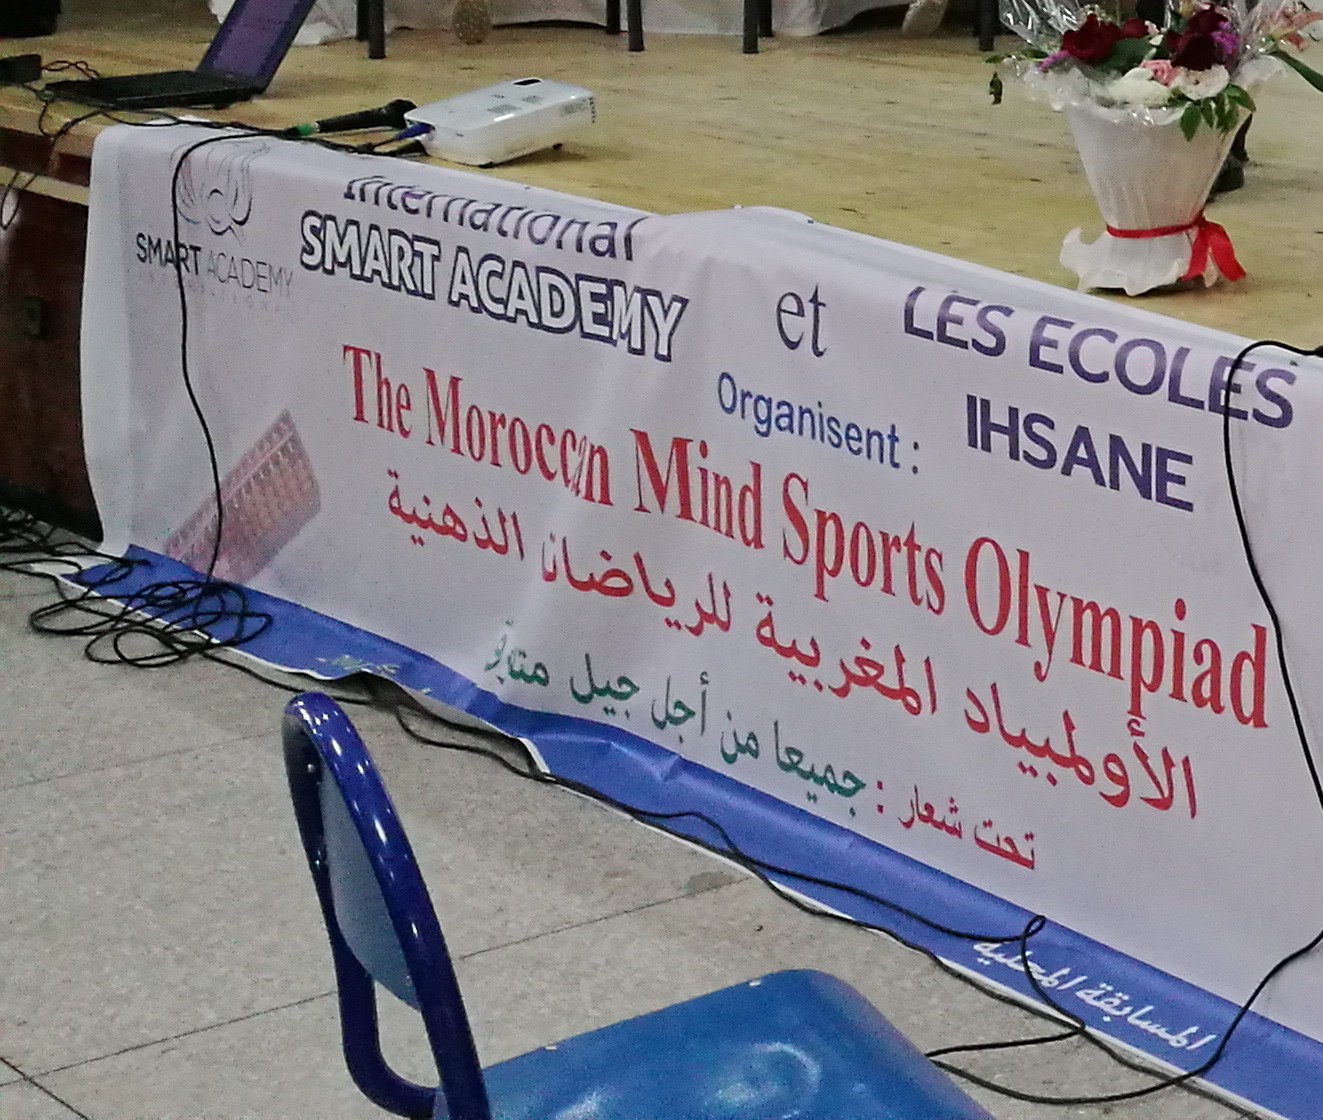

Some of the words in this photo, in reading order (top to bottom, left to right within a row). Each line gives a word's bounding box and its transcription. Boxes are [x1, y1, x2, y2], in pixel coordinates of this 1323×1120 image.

[343, 175, 651, 262] International
[136, 232, 202, 276] SMART
[206, 250, 295, 298] ACADEMY
[300, 209, 441, 301] SMART
[448, 244, 690, 363] ACADEMY
[776, 283, 828, 357] et
[904, 285, 1015, 358] LES
[1028, 315, 1299, 429] ECOLES
[966, 394, 1195, 513] IHSANE
[342, 343, 413, 439] The
[629, 427, 765, 551] Mind
[782, 472, 945, 616] Sports
[963, 535, 1269, 730] Olympiad
[386, 468, 526, 562] الذهنية
[569, 652, 640, 720] جيل
[755, 592, 938, 717] المغربية
[651, 670, 709, 744] أجل
[720, 710, 761, 765] من
[774, 720, 866, 818] جميعا
[963, 682, 1198, 820] الأولمبياد
[898, 783, 963, 839] شعار
[973, 819, 1035, 870] تحت
[1075, 982, 1217, 1051] المسابقة
